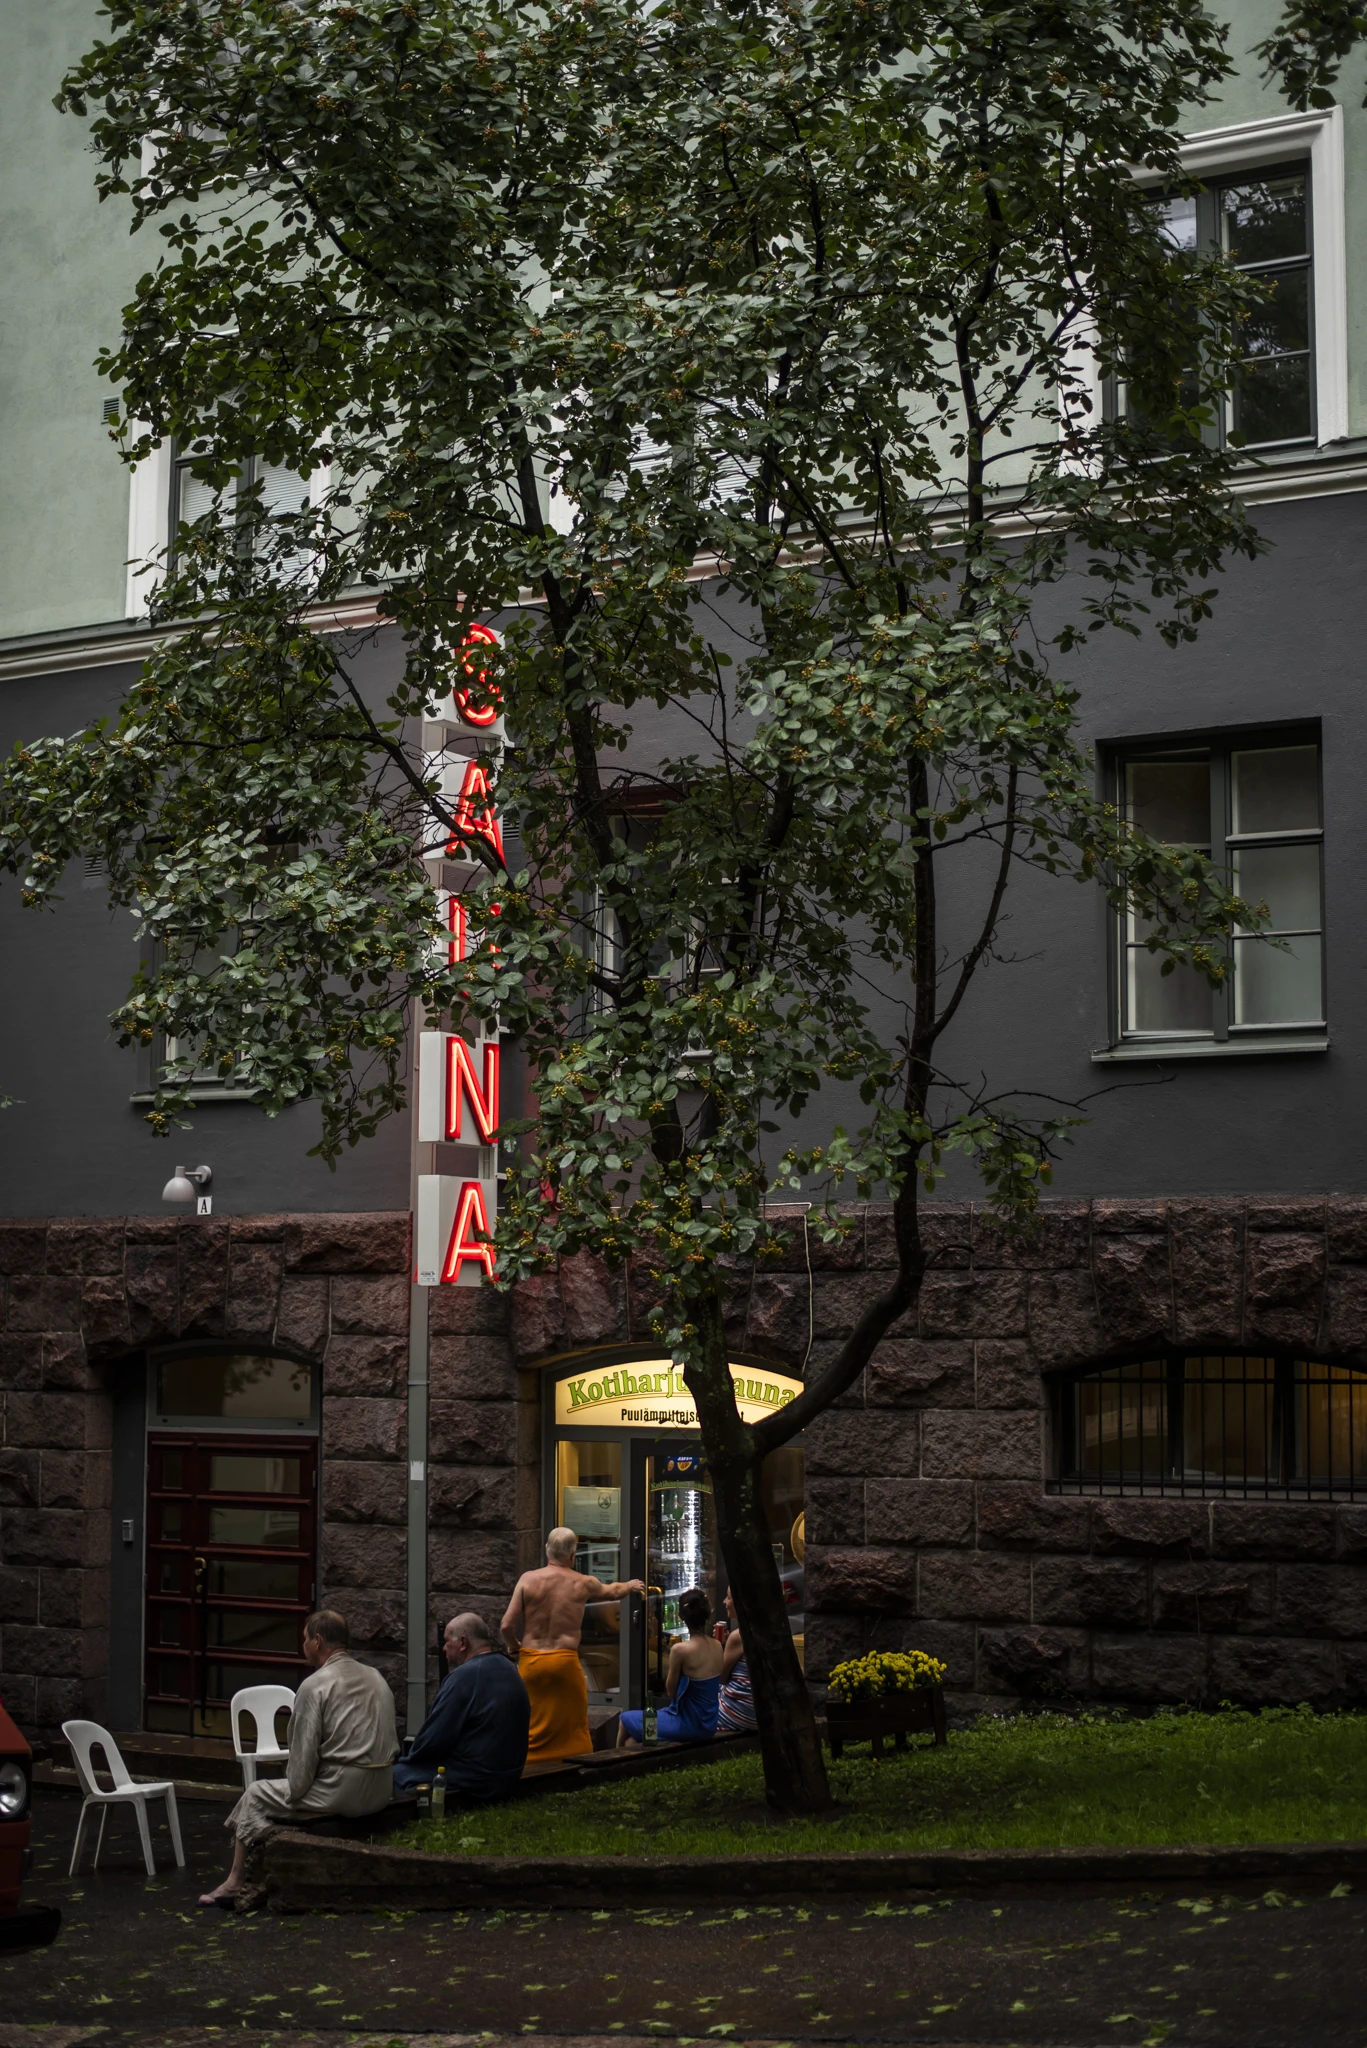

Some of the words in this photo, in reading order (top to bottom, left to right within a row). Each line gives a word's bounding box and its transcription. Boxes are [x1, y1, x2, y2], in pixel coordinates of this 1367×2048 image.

[196, 1198, 208, 1213] A
[567, 1367, 690, 1407] Kotiharju
[733, 1377, 796, 1407] auna
[621, 1408, 701, 1423] Puulämmitteise
